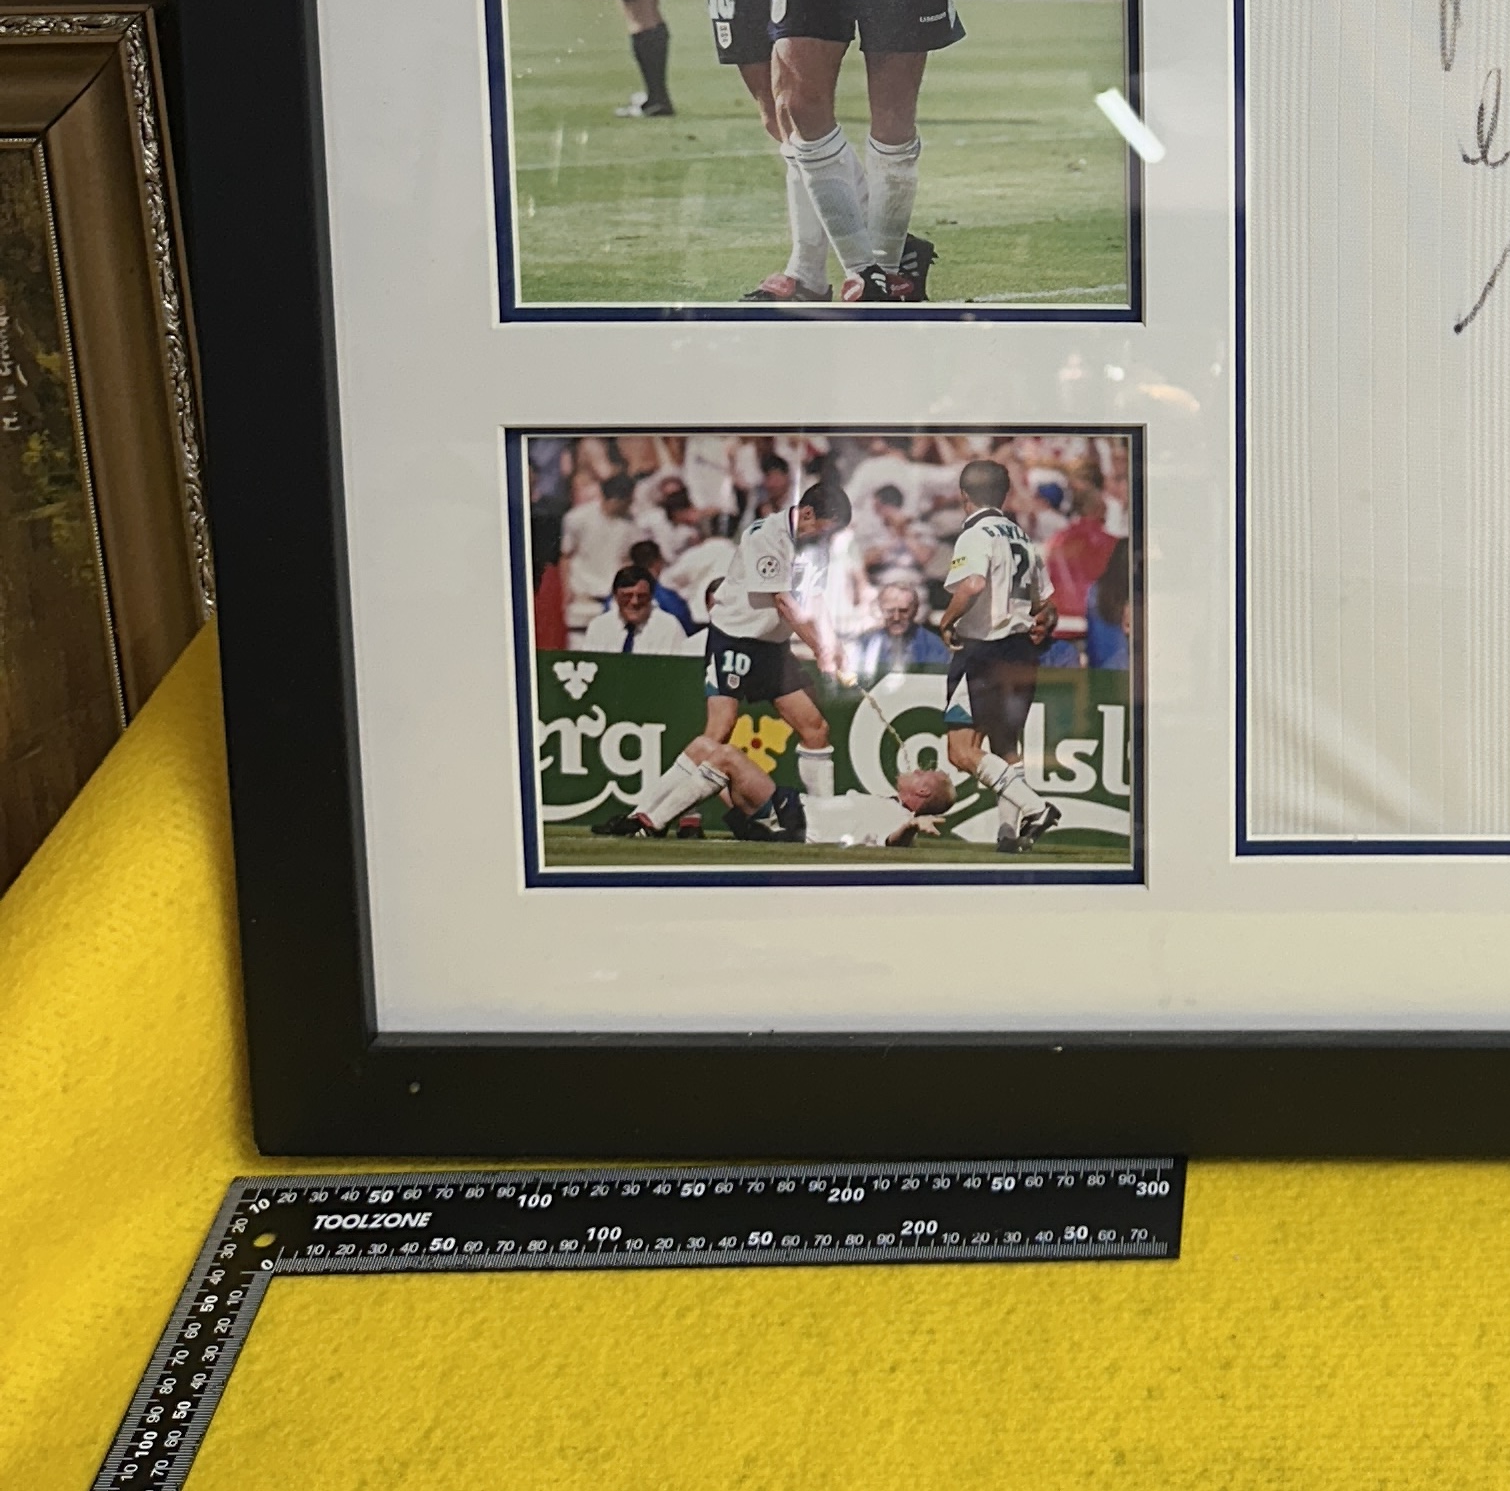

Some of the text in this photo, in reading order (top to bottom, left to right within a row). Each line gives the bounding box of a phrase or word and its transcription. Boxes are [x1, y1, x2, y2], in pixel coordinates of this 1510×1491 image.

[721, 650, 752, 677] 10
[249, 1174, 1170, 1214] 10 20 30 40 50 60 70 80 90 100 10 20 30 40 50 60 70 80 90 200 10 20 30 40 50 60 70 80 90 300
[313, 1212, 433, 1230] TOOLZONE
[260, 1220, 1148, 1271] 0 10 20 30 40 50 60 70 80 90 100 10 20 30 40 50 60 70 80 90 200 10 20 30 40 50 60 70
[121, 1218, 248, 1481] 20 30 40 50 60 70 80 90 100 10
[150, 1290, 243, 1477] 10 20 30 40 50 60 70
